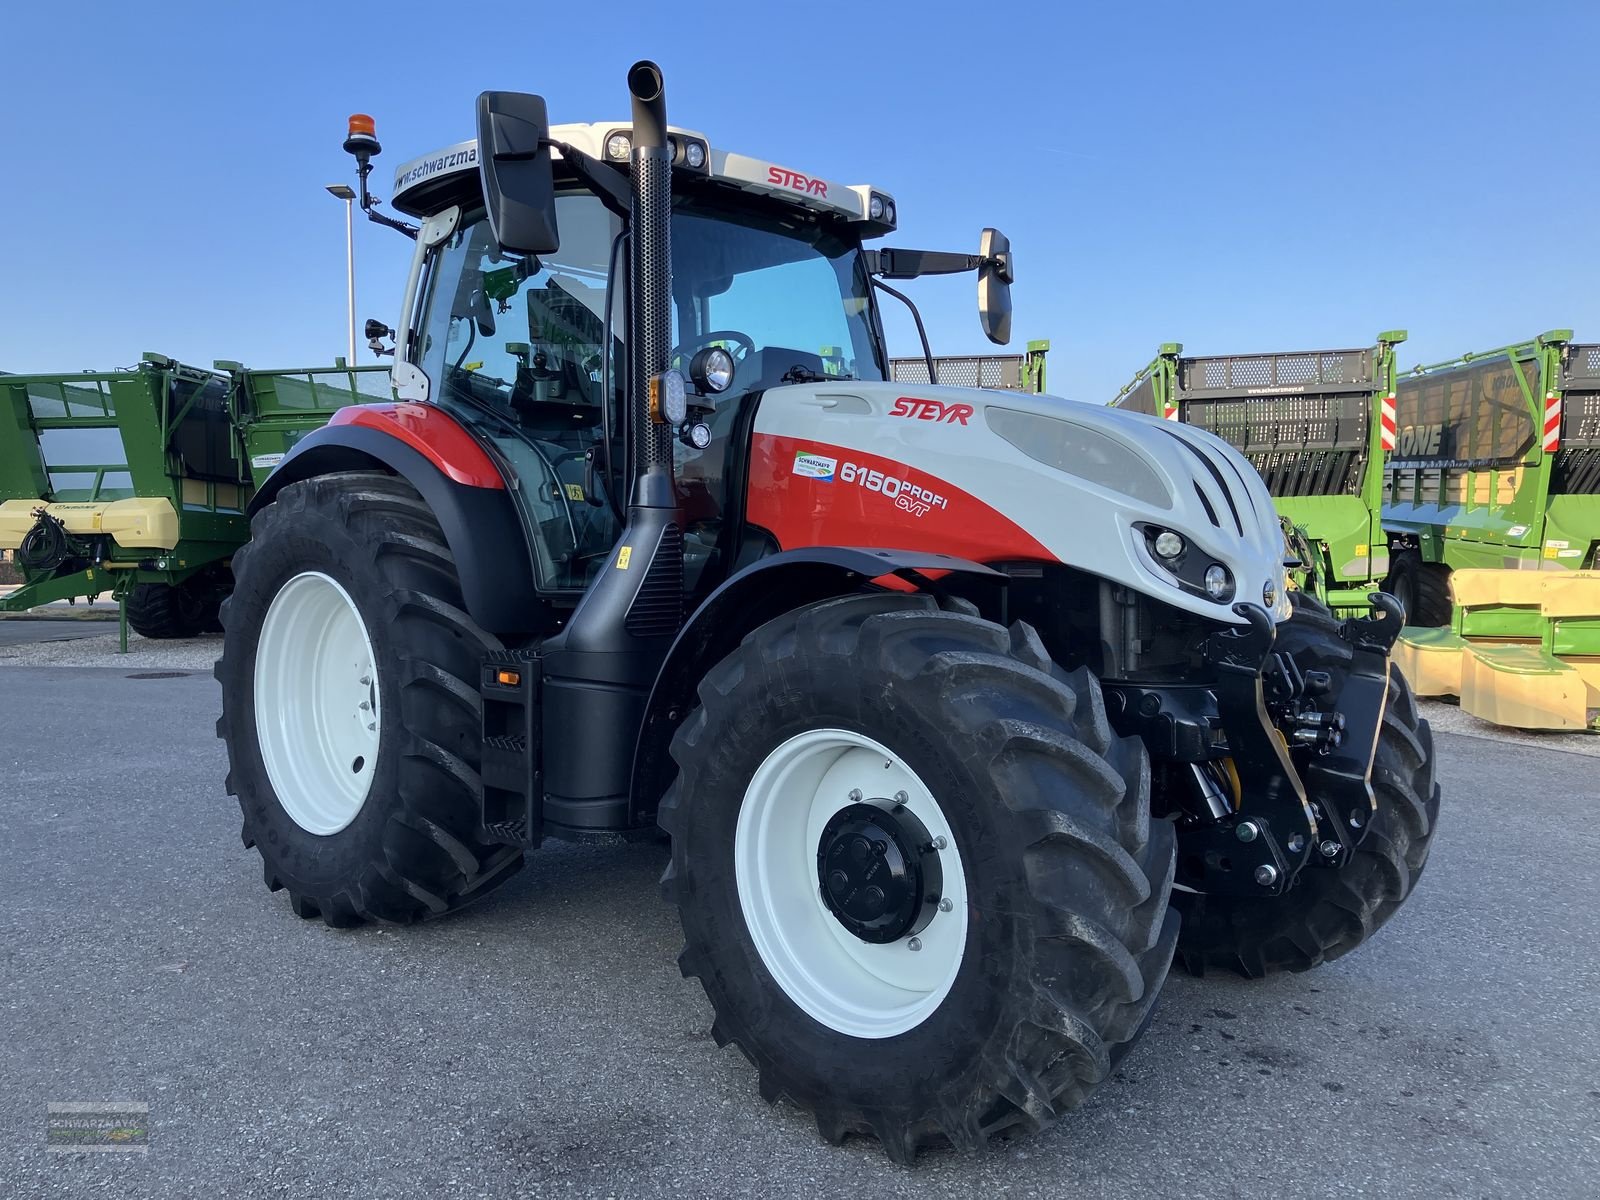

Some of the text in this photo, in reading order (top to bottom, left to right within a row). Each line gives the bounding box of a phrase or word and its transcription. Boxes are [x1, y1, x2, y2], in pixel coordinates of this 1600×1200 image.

[395, 148, 480, 189] ww.schwarzma
[768, 166, 827, 199] STEYR
[888, 397, 974, 426] STEYR
[798, 456, 831, 469] SCHWARZMAYR
[840, 461, 948, 510] 6150 PROFI
[895, 494, 930, 518] CVT
